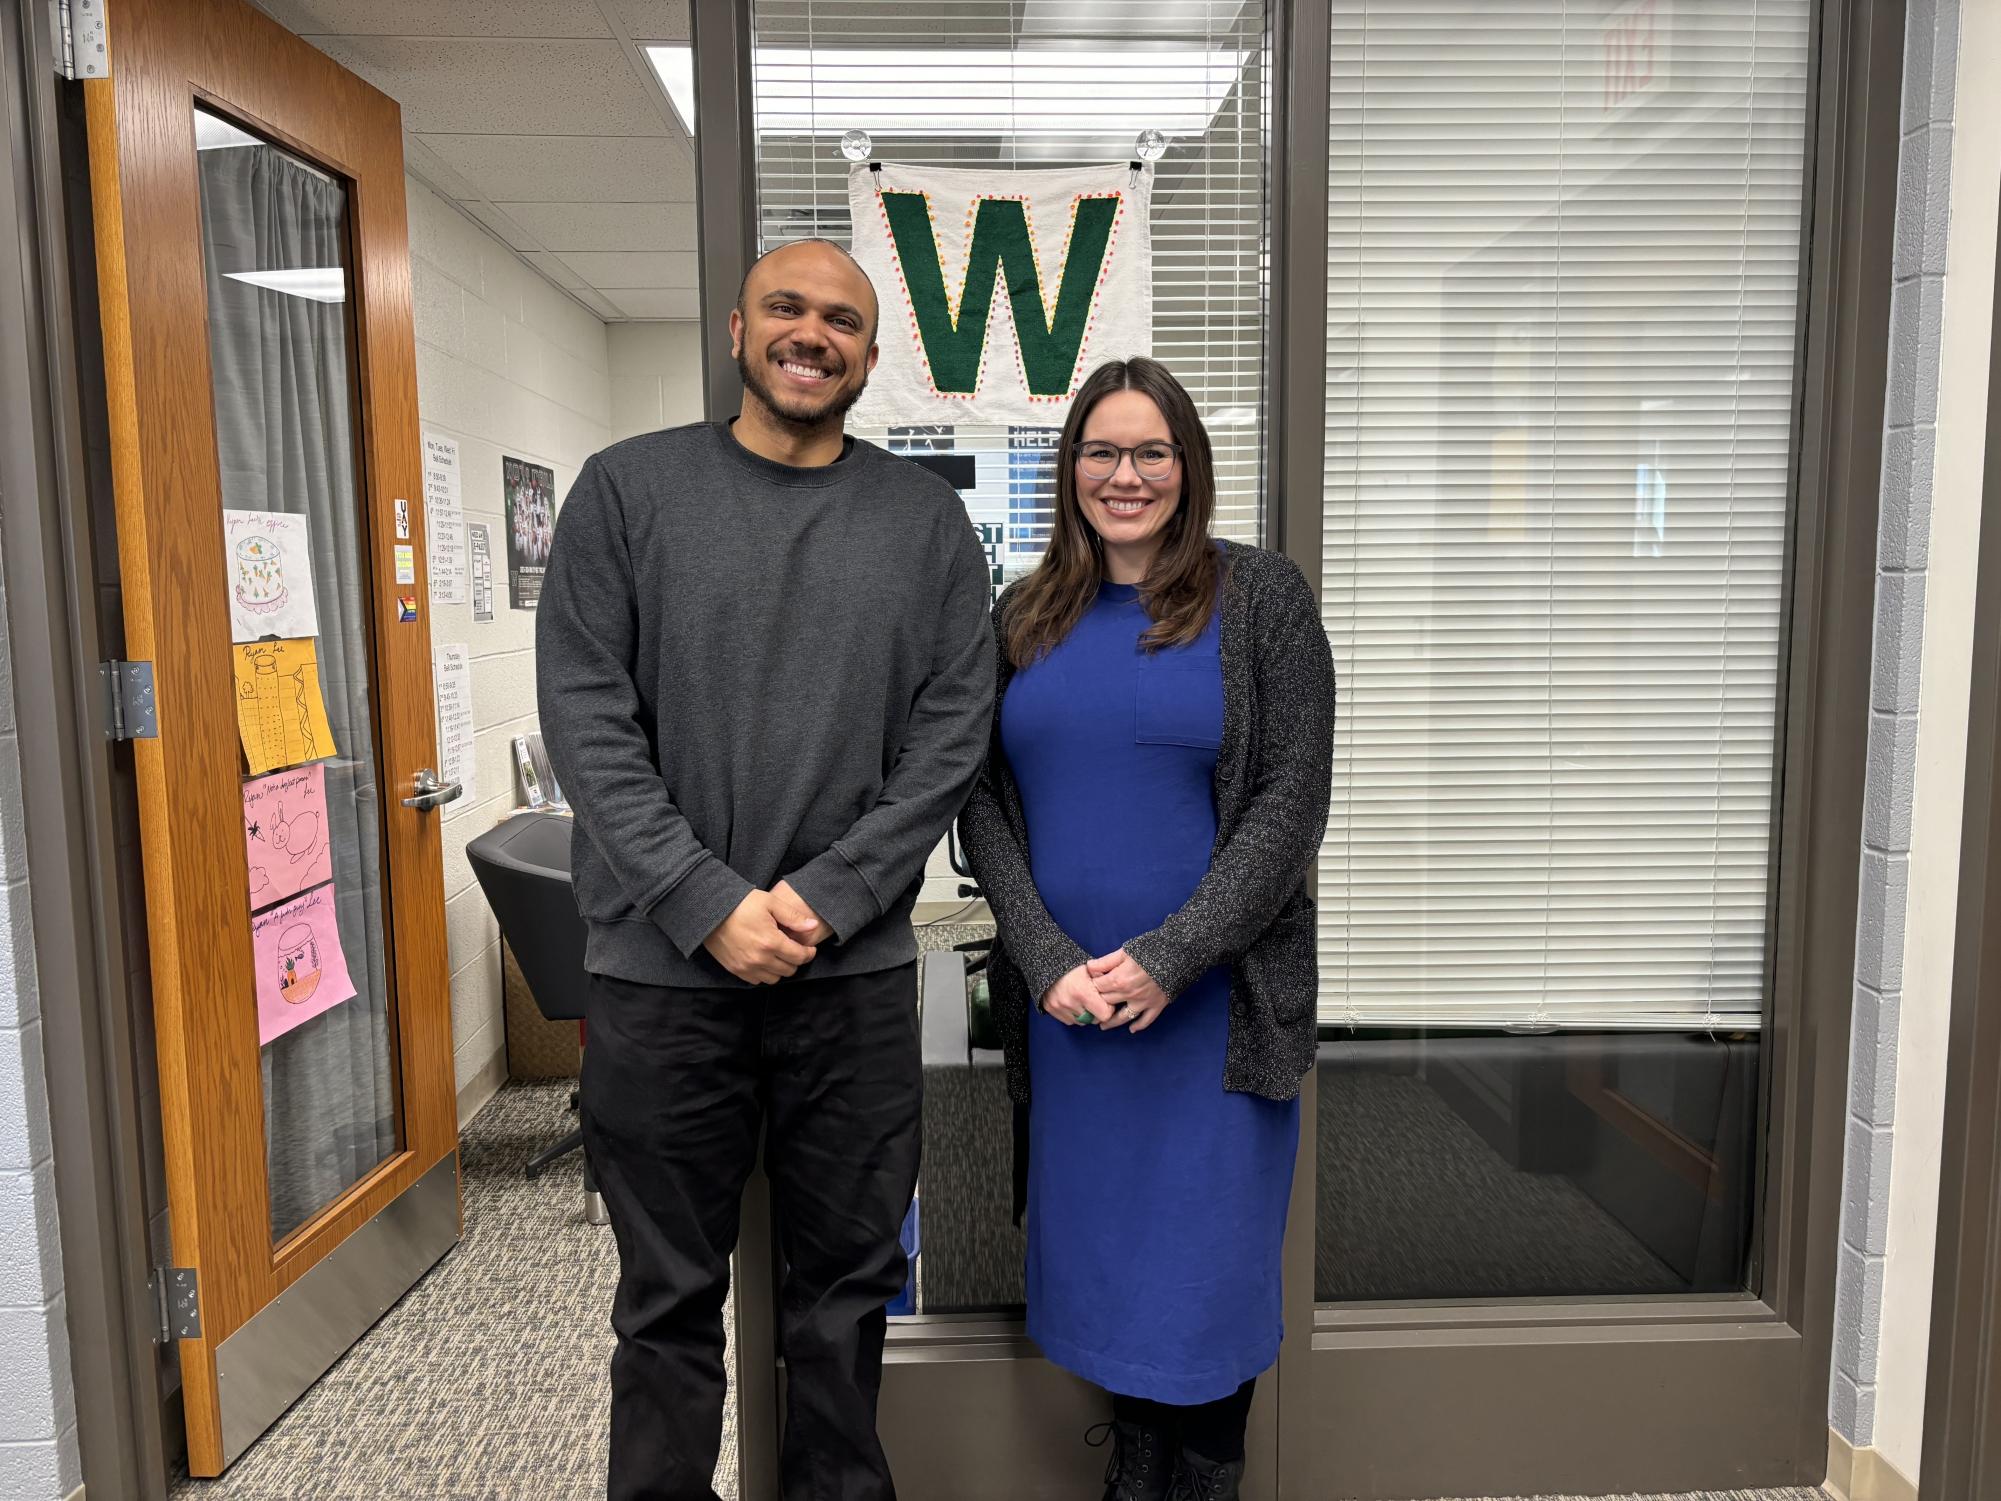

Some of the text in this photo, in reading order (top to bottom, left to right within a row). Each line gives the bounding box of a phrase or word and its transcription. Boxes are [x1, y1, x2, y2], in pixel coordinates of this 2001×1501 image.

[879, 190, 1120, 397] W
[1013, 431, 1061, 447] HELP
[242, 644, 267, 665] Ryan
[244, 789, 264, 809] Ryan
